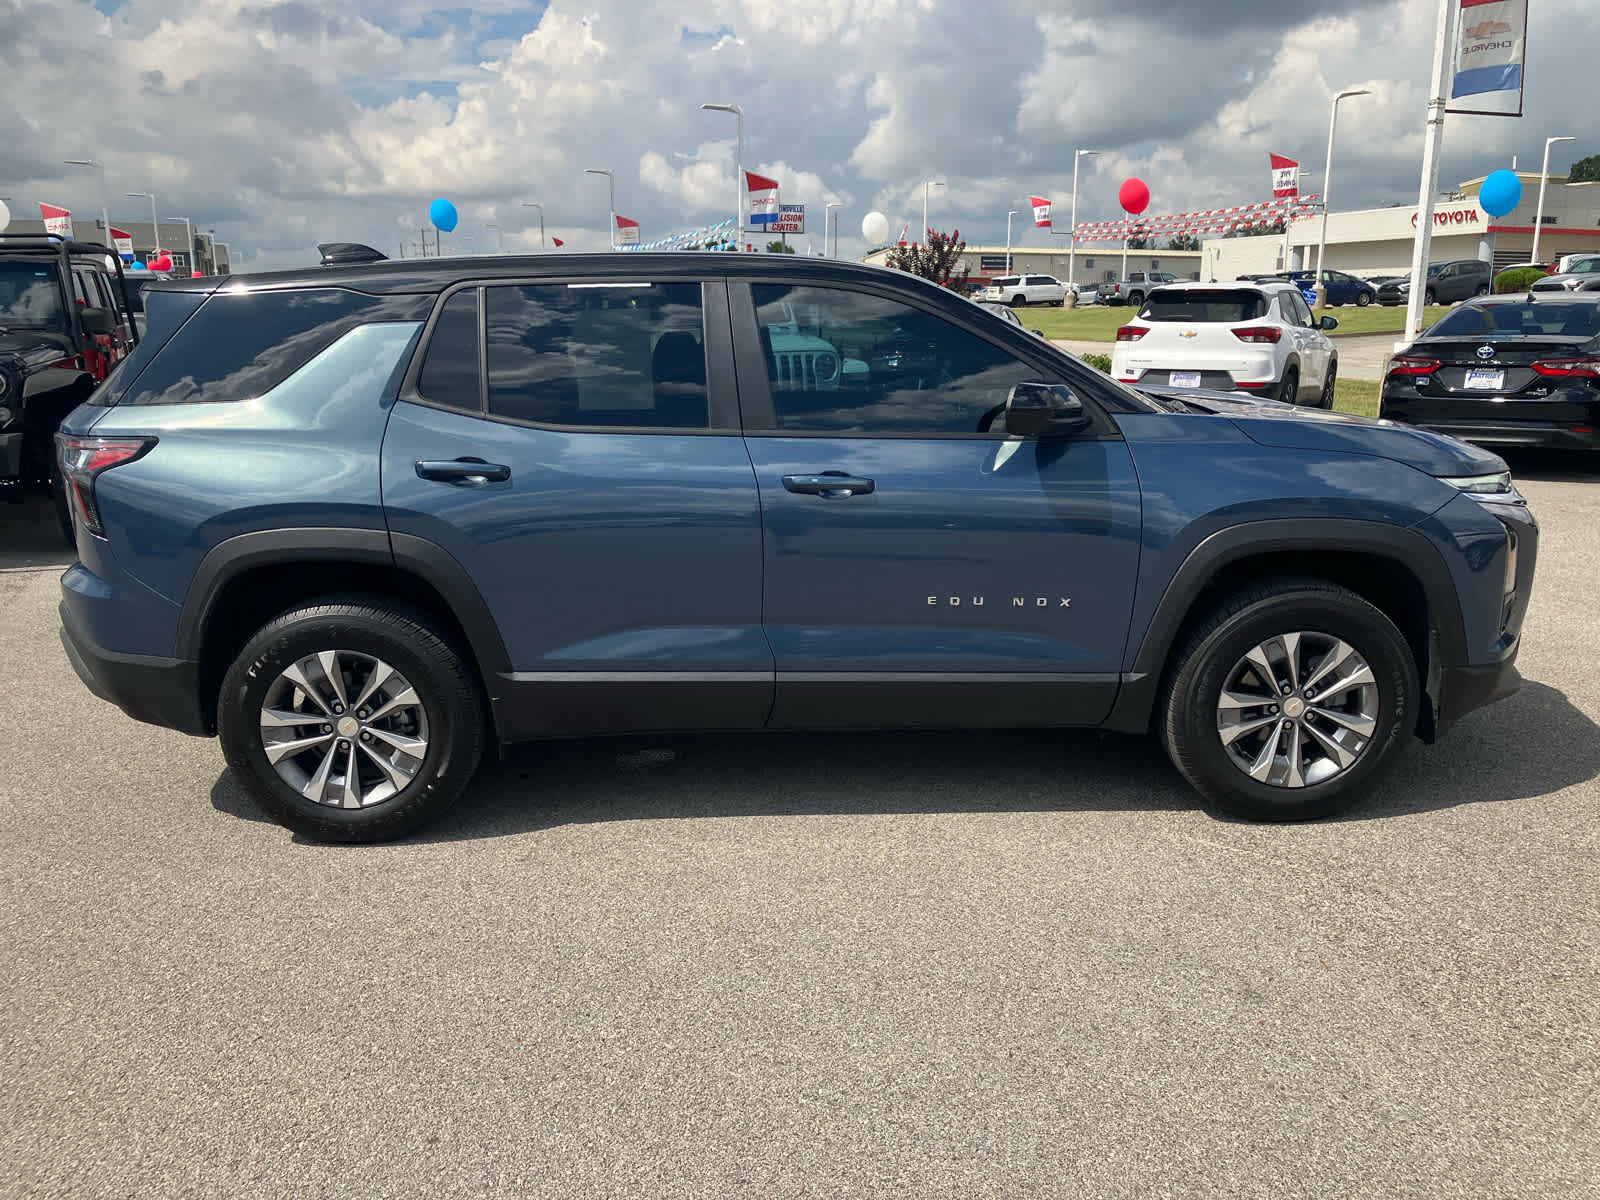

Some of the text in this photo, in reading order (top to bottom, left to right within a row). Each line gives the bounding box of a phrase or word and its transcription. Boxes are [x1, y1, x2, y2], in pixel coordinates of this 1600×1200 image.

[780, 213, 802, 222] LISION
[1433, 209, 1478, 225] TOYOTA
[771, 223, 798, 231] CENTER
[927, 596, 1071, 607] EQUNOX
